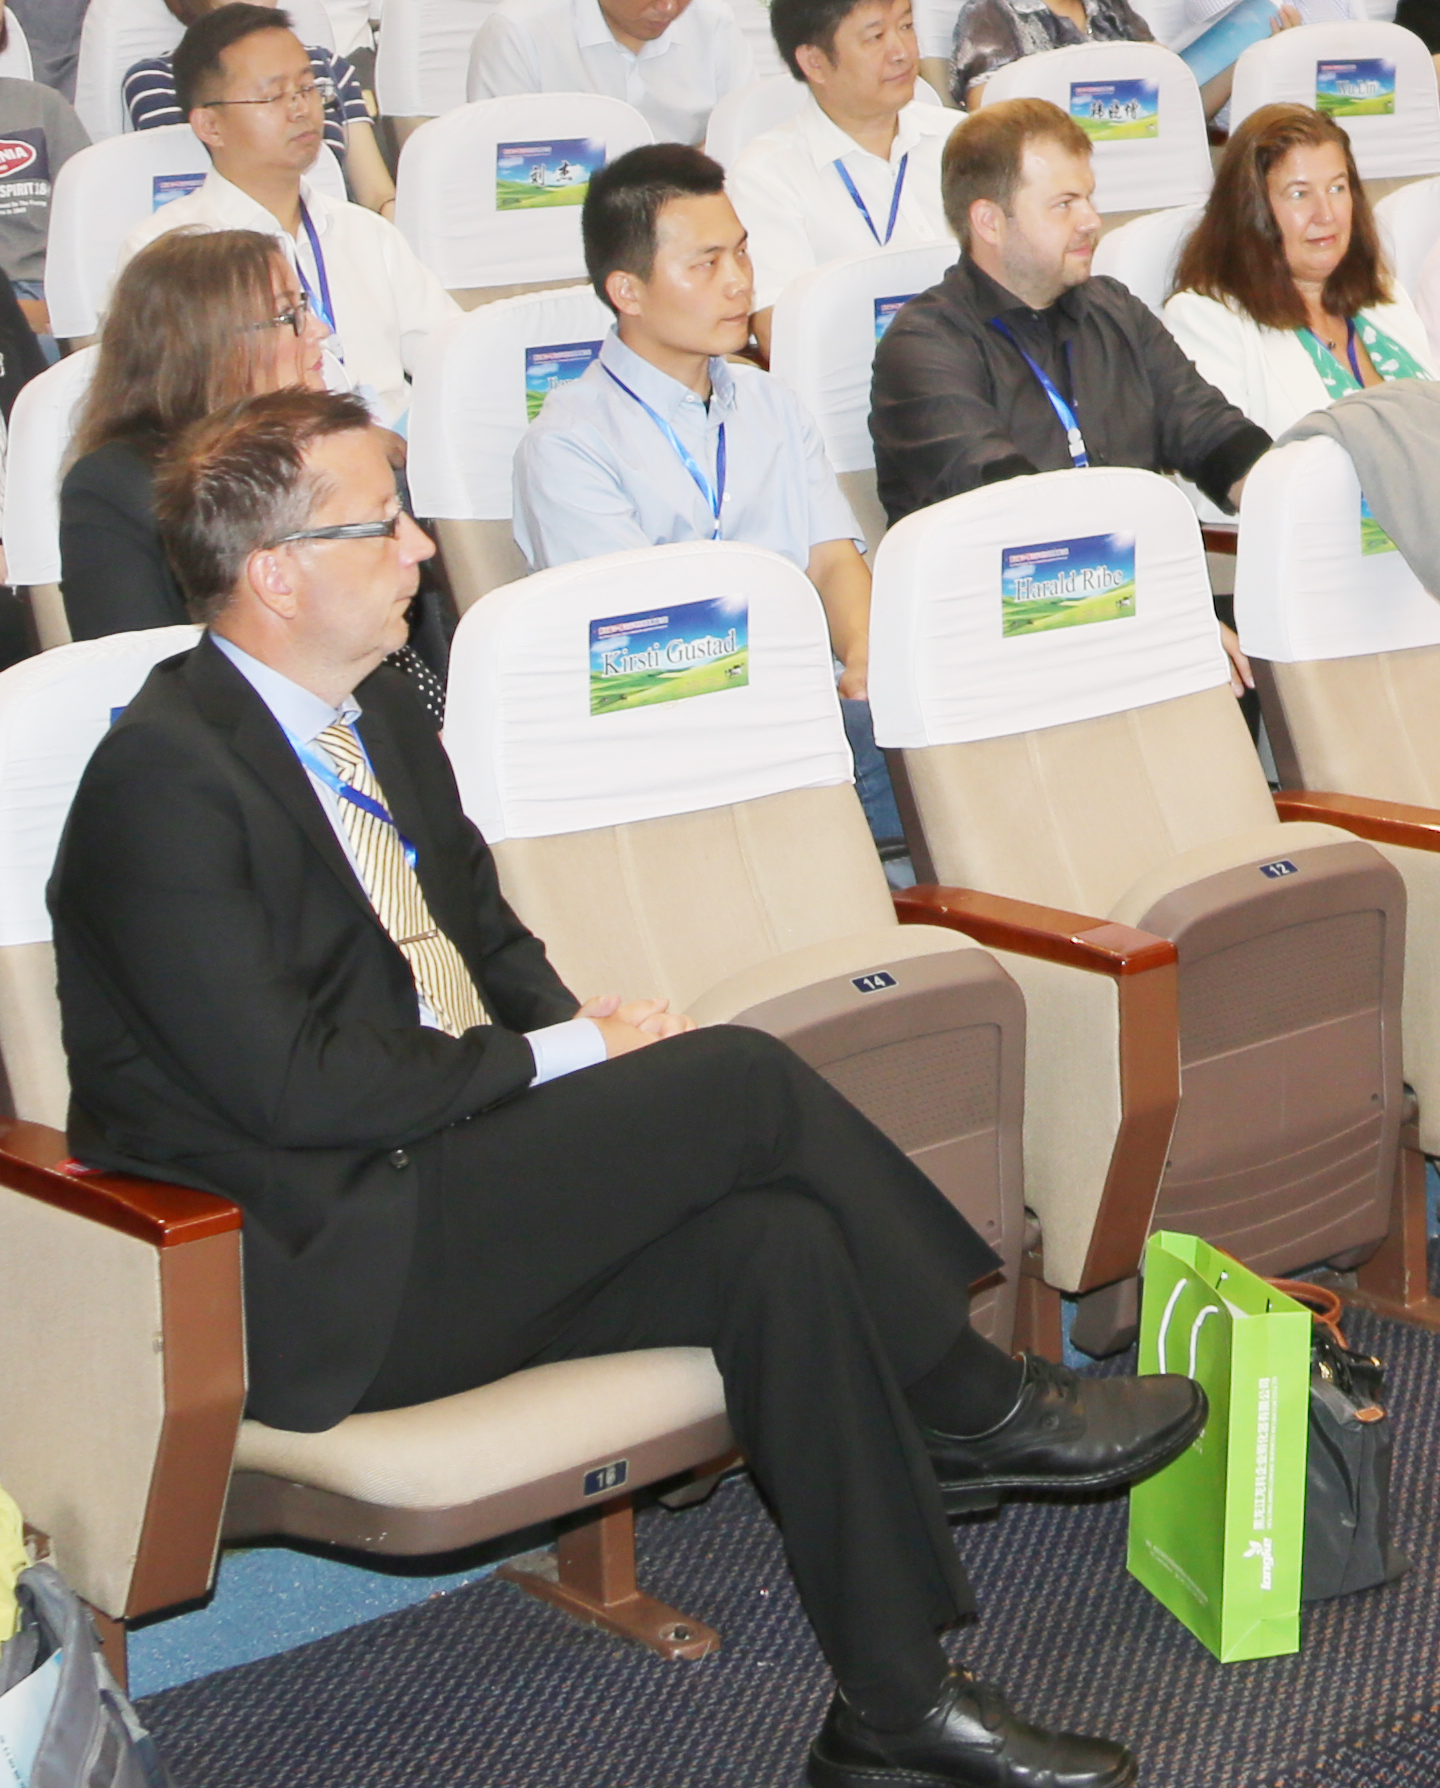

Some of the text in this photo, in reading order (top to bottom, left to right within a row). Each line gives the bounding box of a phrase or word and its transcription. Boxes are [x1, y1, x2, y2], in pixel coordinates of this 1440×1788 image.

[1015, 565, 1123, 602] Harald Ribe
[603, 643, 660, 676] Kirsti
[666, 628, 737, 664] Gustad
[1269, 863, 1290, 877] 12
[863, 975, 886, 990] 14
[596, 1466, 616, 1488] 16
